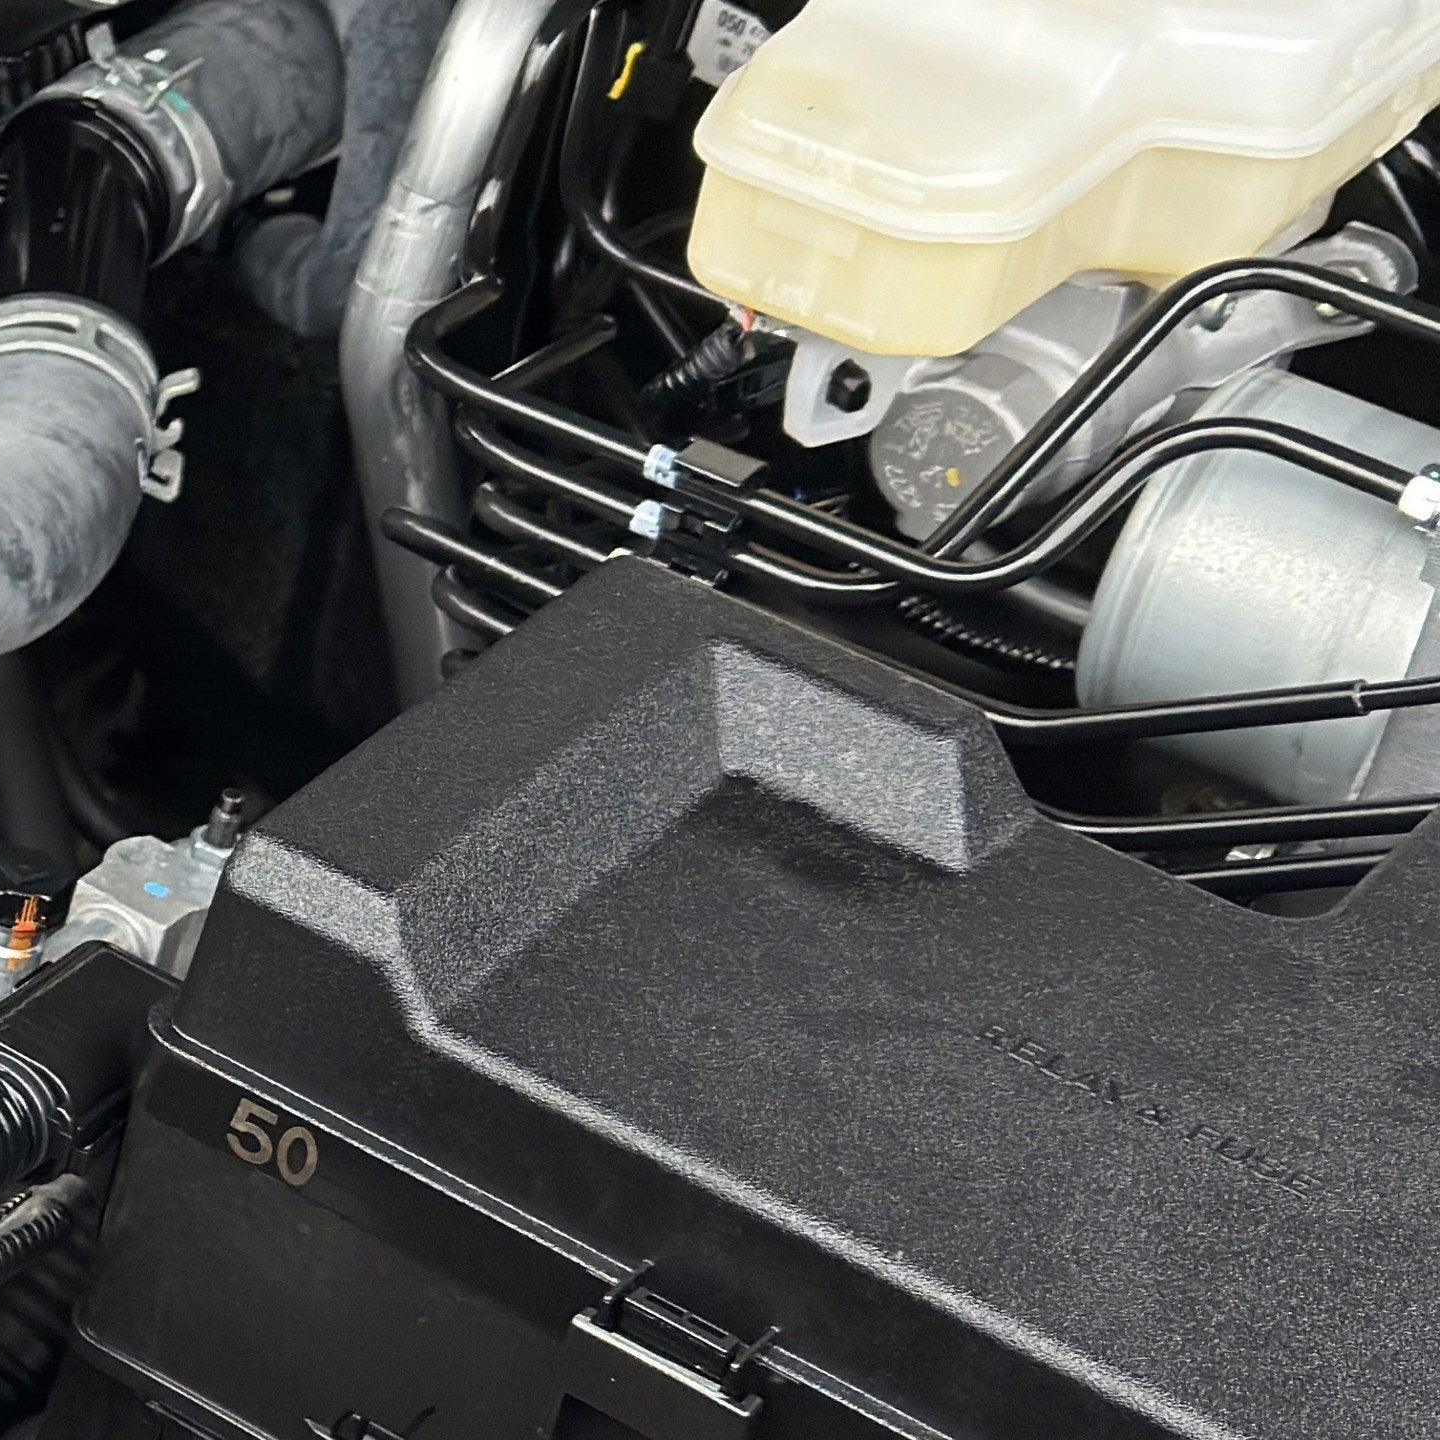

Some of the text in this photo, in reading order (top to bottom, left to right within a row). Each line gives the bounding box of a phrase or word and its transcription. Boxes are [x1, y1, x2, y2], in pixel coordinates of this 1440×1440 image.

[226, 1098, 319, 1187] 50
[974, 1024, 1123, 1105] RELAY
[1183, 1123, 1321, 1201] FUSE
